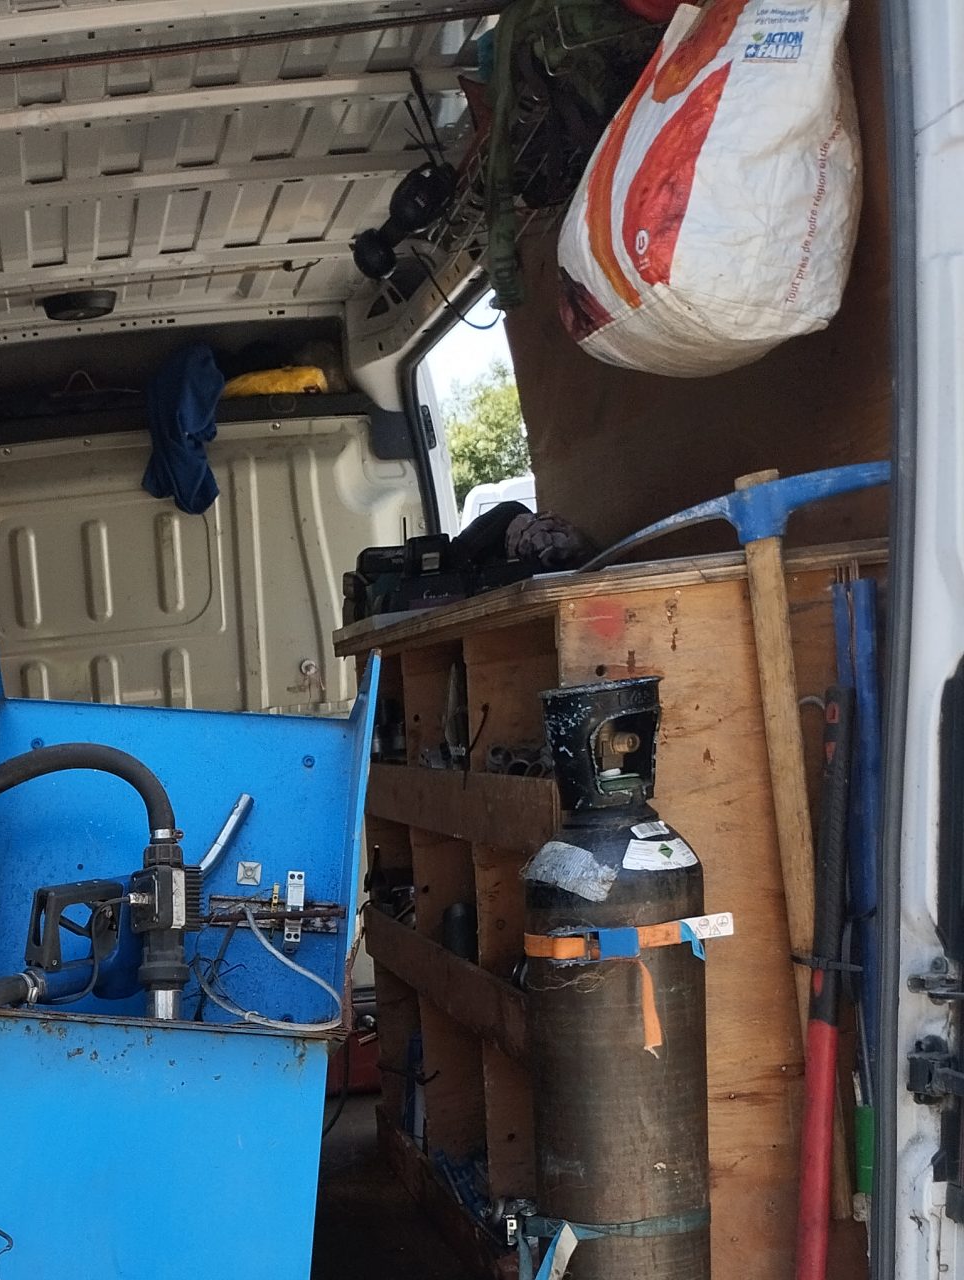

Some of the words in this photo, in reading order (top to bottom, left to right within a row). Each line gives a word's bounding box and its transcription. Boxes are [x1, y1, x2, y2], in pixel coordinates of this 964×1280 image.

[764, 31, 804, 45] ACTION
[756, 44, 802, 58] FAIM
[812, 170, 826, 207] région
[808, 209, 817, 239] notre
[801, 240, 812, 253] de
[796, 256, 810, 280] près
[785, 281, 800, 304] Tout
